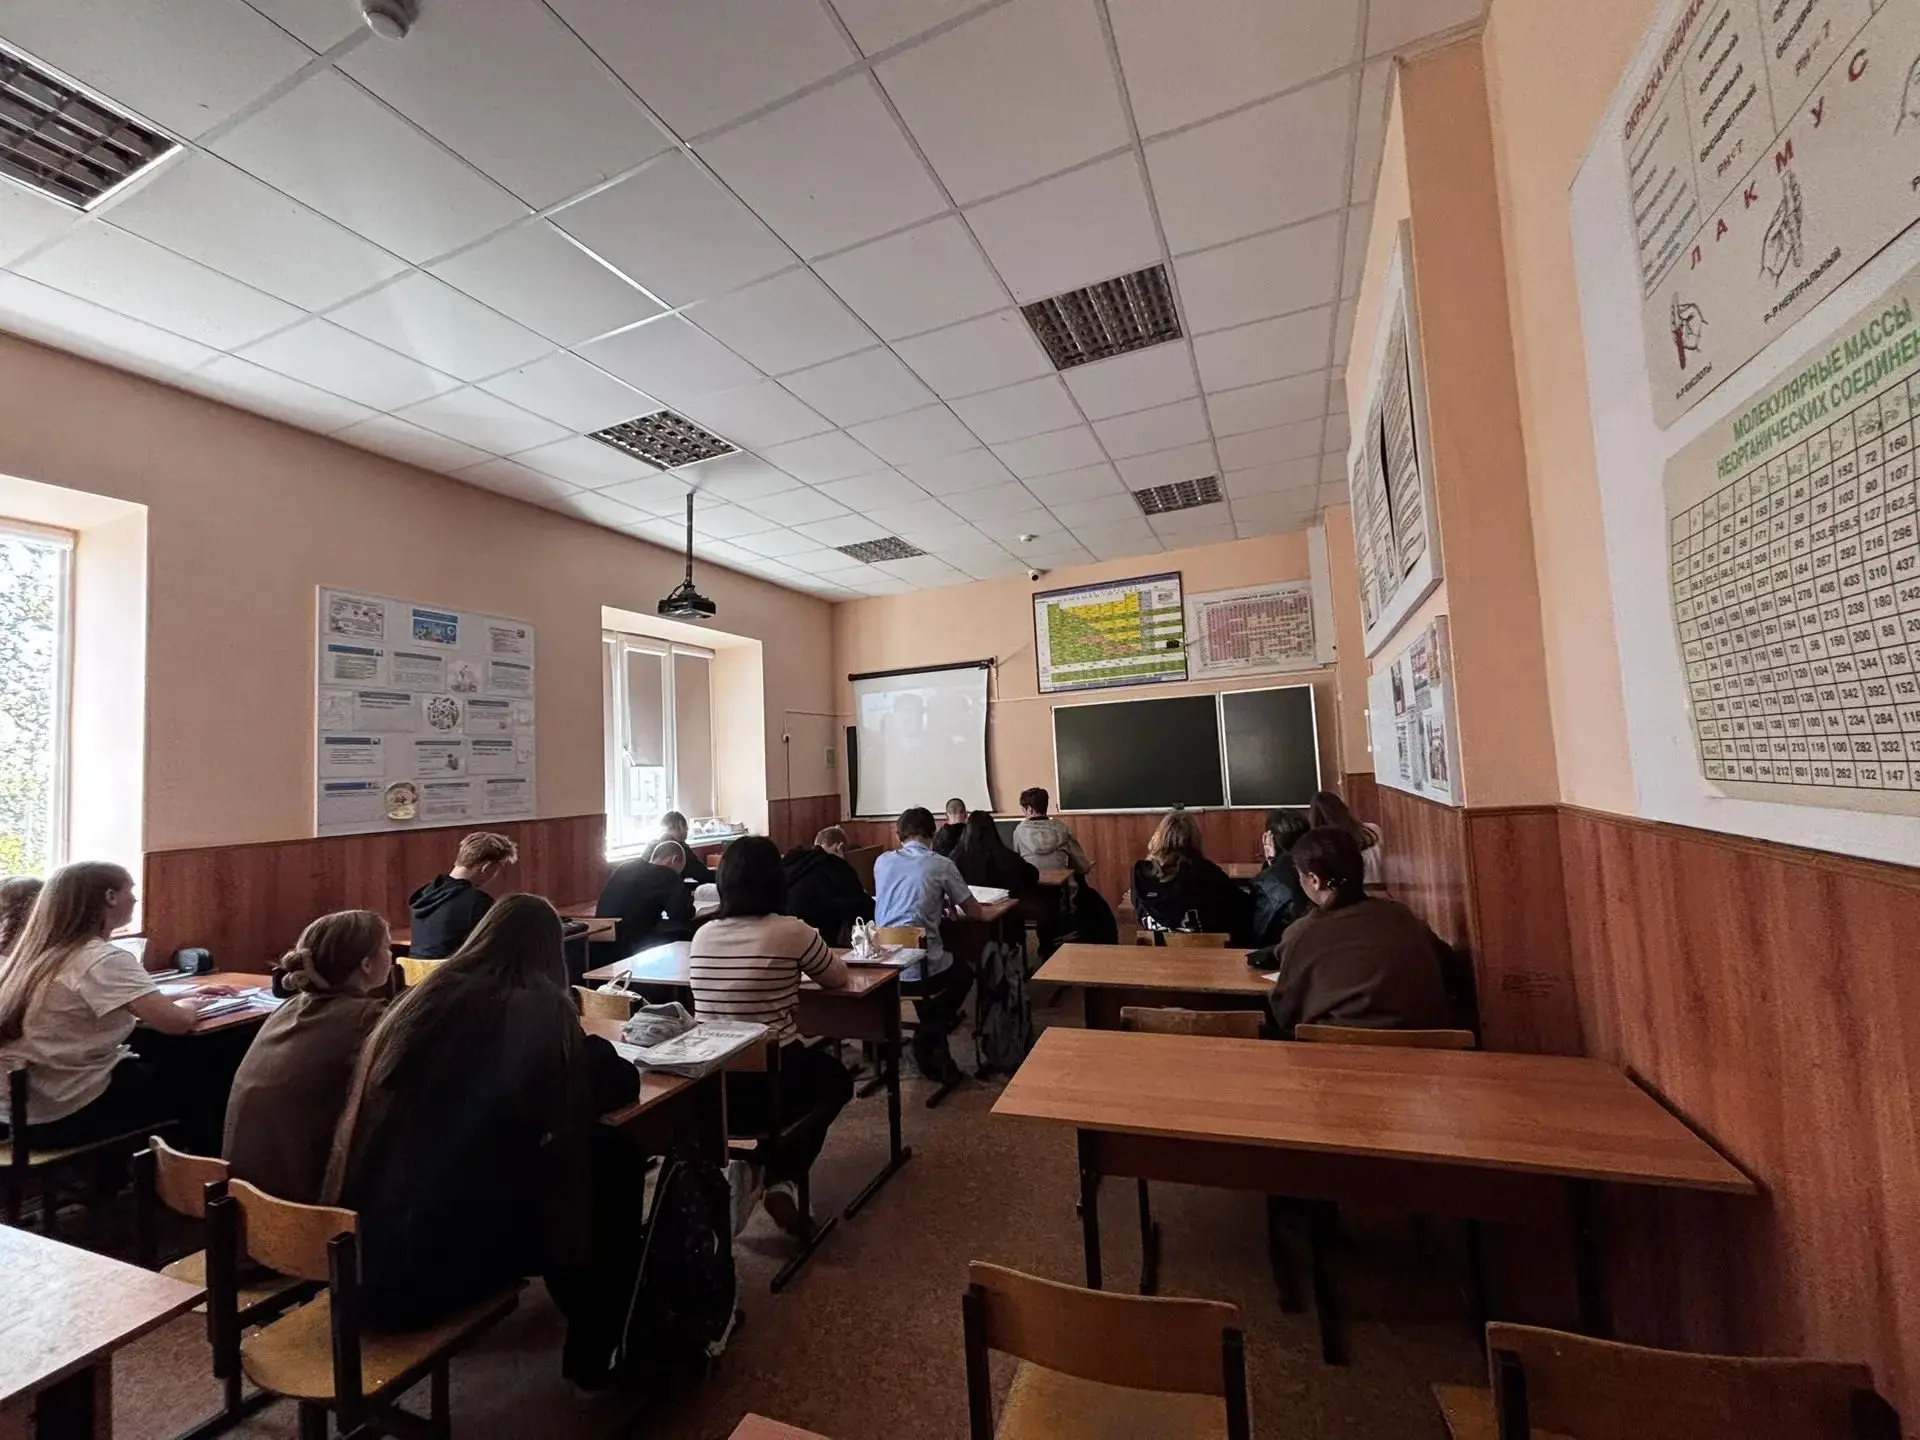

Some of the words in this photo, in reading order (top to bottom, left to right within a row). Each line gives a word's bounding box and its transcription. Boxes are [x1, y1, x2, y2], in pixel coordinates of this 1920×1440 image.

[1733, 347, 1844, 443] МОЛЕКУЛЯРНЫЕ
[1843, 297, 1912, 367] МАССЫ
[1717, 393, 1829, 480] НЕОРГАНИЧЕСКИХ
[1865, 450, 1876, 464] 72
[1890, 435, 1907, 452] 160
[1890, 464, 1908, 482] 107
[1864, 506, 1880, 522] 127
[1886, 492, 1916, 514] 162.5
[1865, 536, 1884, 552] 216
[1892, 524, 1912, 542] 296
[1868, 564, 1888, 580] 310
[1896, 556, 1915, 570] 437
[1860, 657, 1878, 670] 344
[1887, 652, 1906, 666] 136
[1842, 688, 1860, 700] 342
[1867, 684, 1886, 697] 392
[1896, 681, 1916, 694] 152
[1848, 714, 1866, 726] 234
[1881, 740, 1900, 752] 332
[1860, 768, 1878, 780] 122
[1886, 770, 1904, 781] 147
